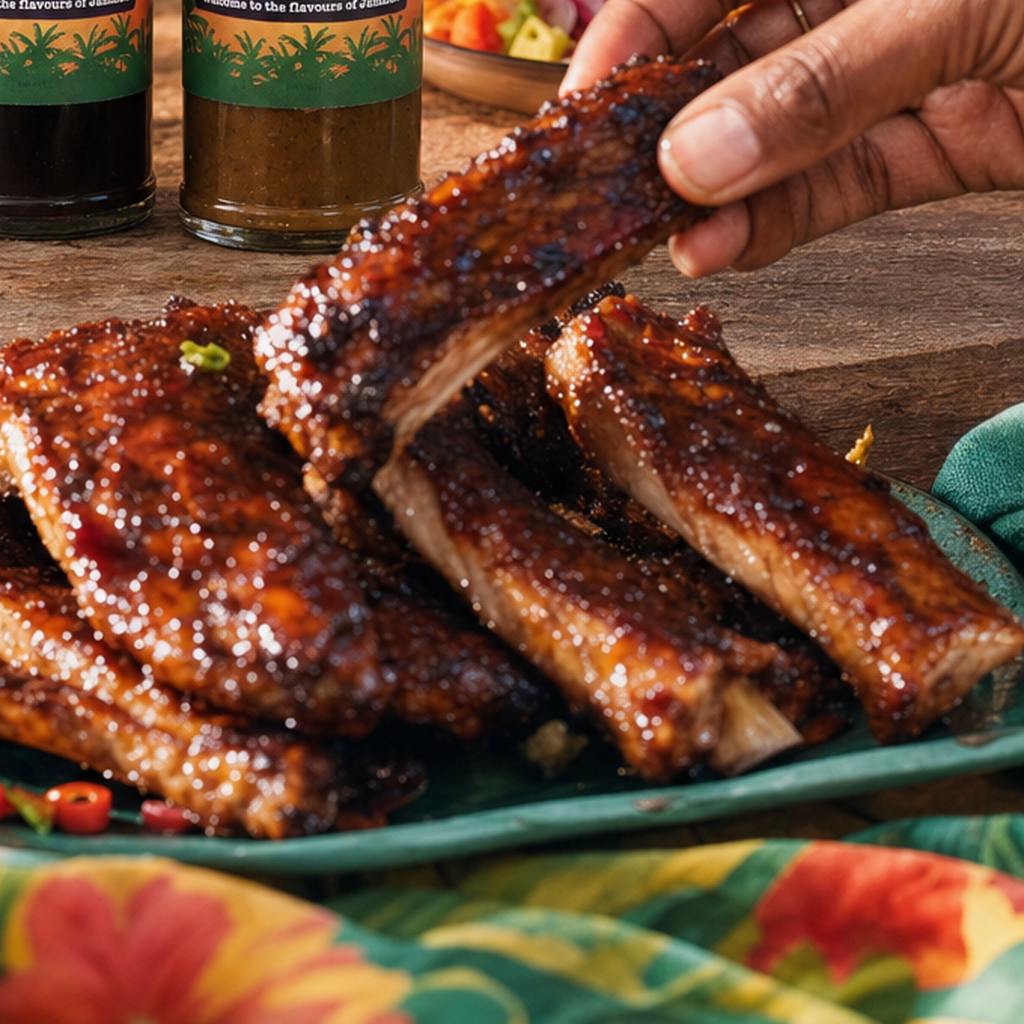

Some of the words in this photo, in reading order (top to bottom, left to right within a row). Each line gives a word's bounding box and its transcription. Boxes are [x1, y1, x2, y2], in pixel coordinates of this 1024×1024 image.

[249, 0, 263, 11] to
[265, 0, 286, 13] the
[289, 1, 343, 13] flavours
[345, 0, 358, 11] of
